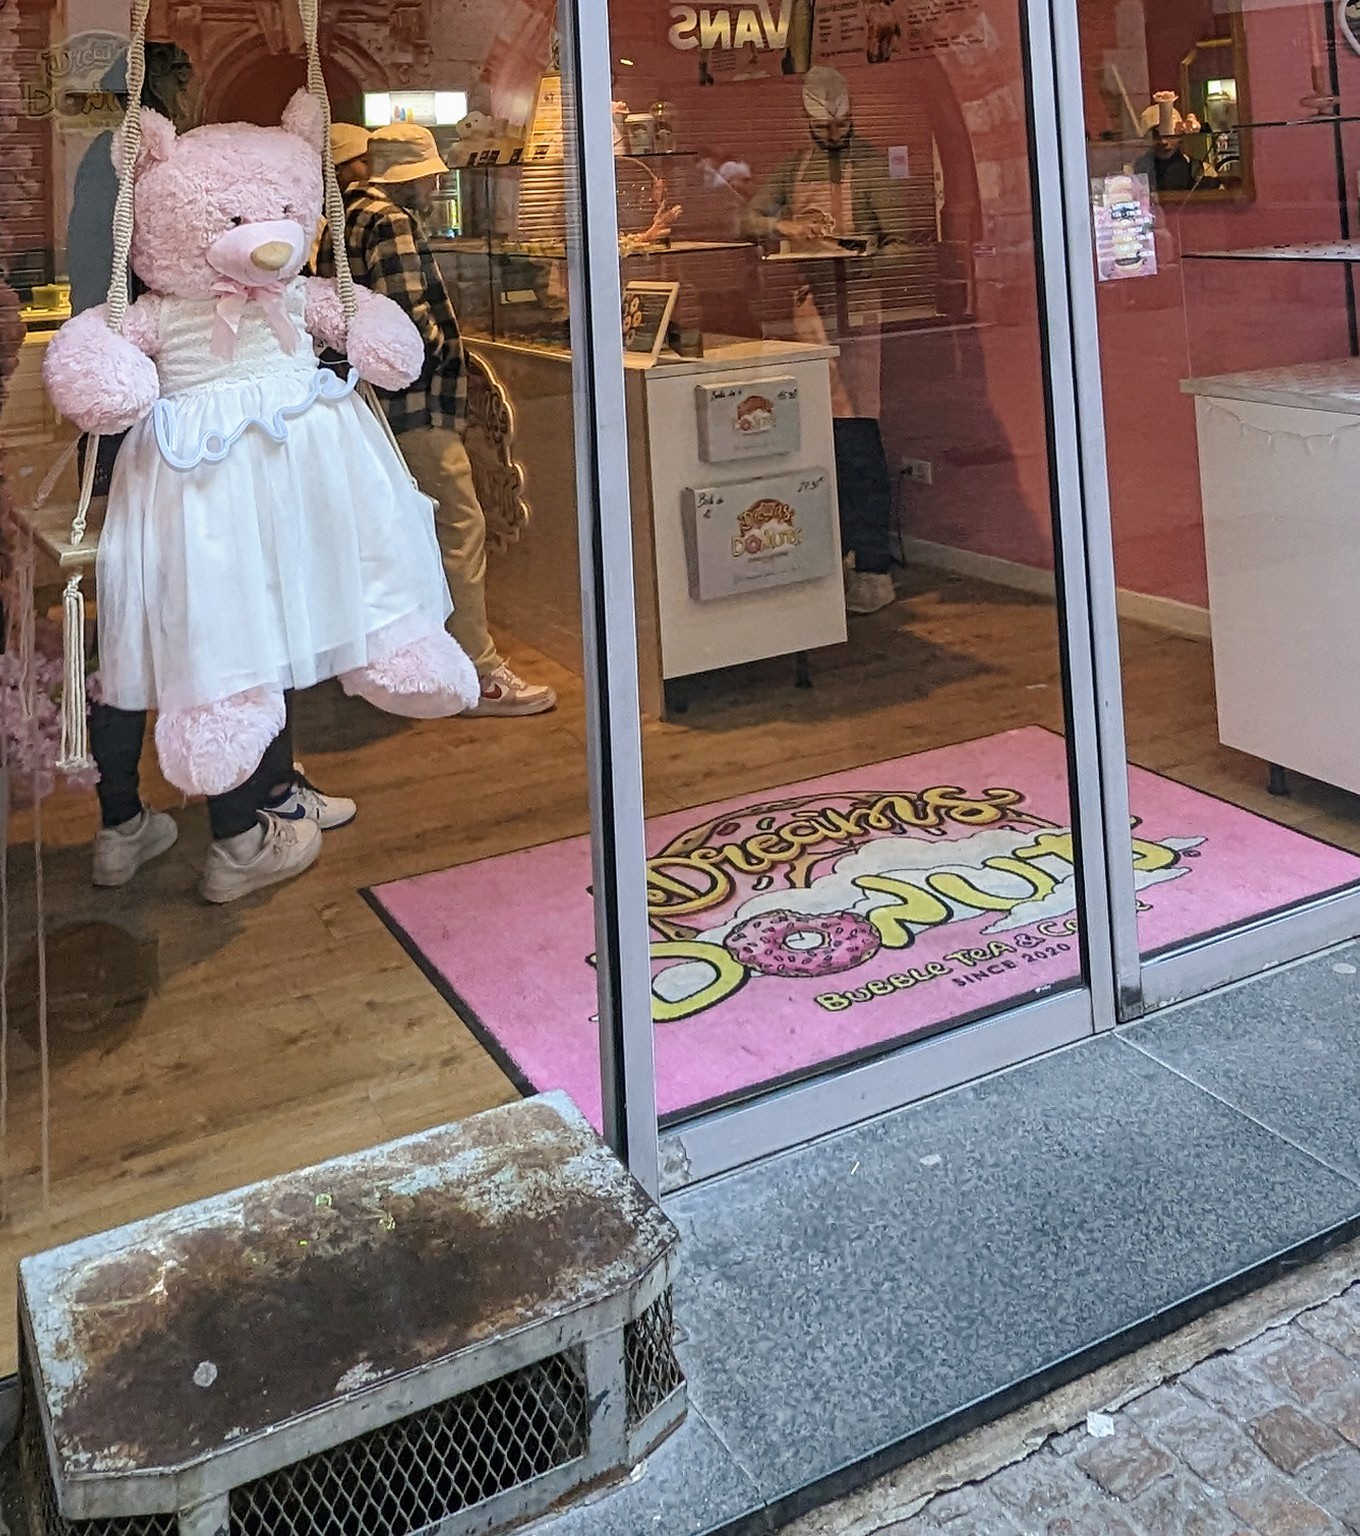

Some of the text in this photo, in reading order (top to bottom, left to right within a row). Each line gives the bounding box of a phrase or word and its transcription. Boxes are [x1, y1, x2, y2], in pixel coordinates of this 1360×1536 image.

[1014, 932, 1045, 949] &
[952, 942, 1072, 987] SINCE 2020
